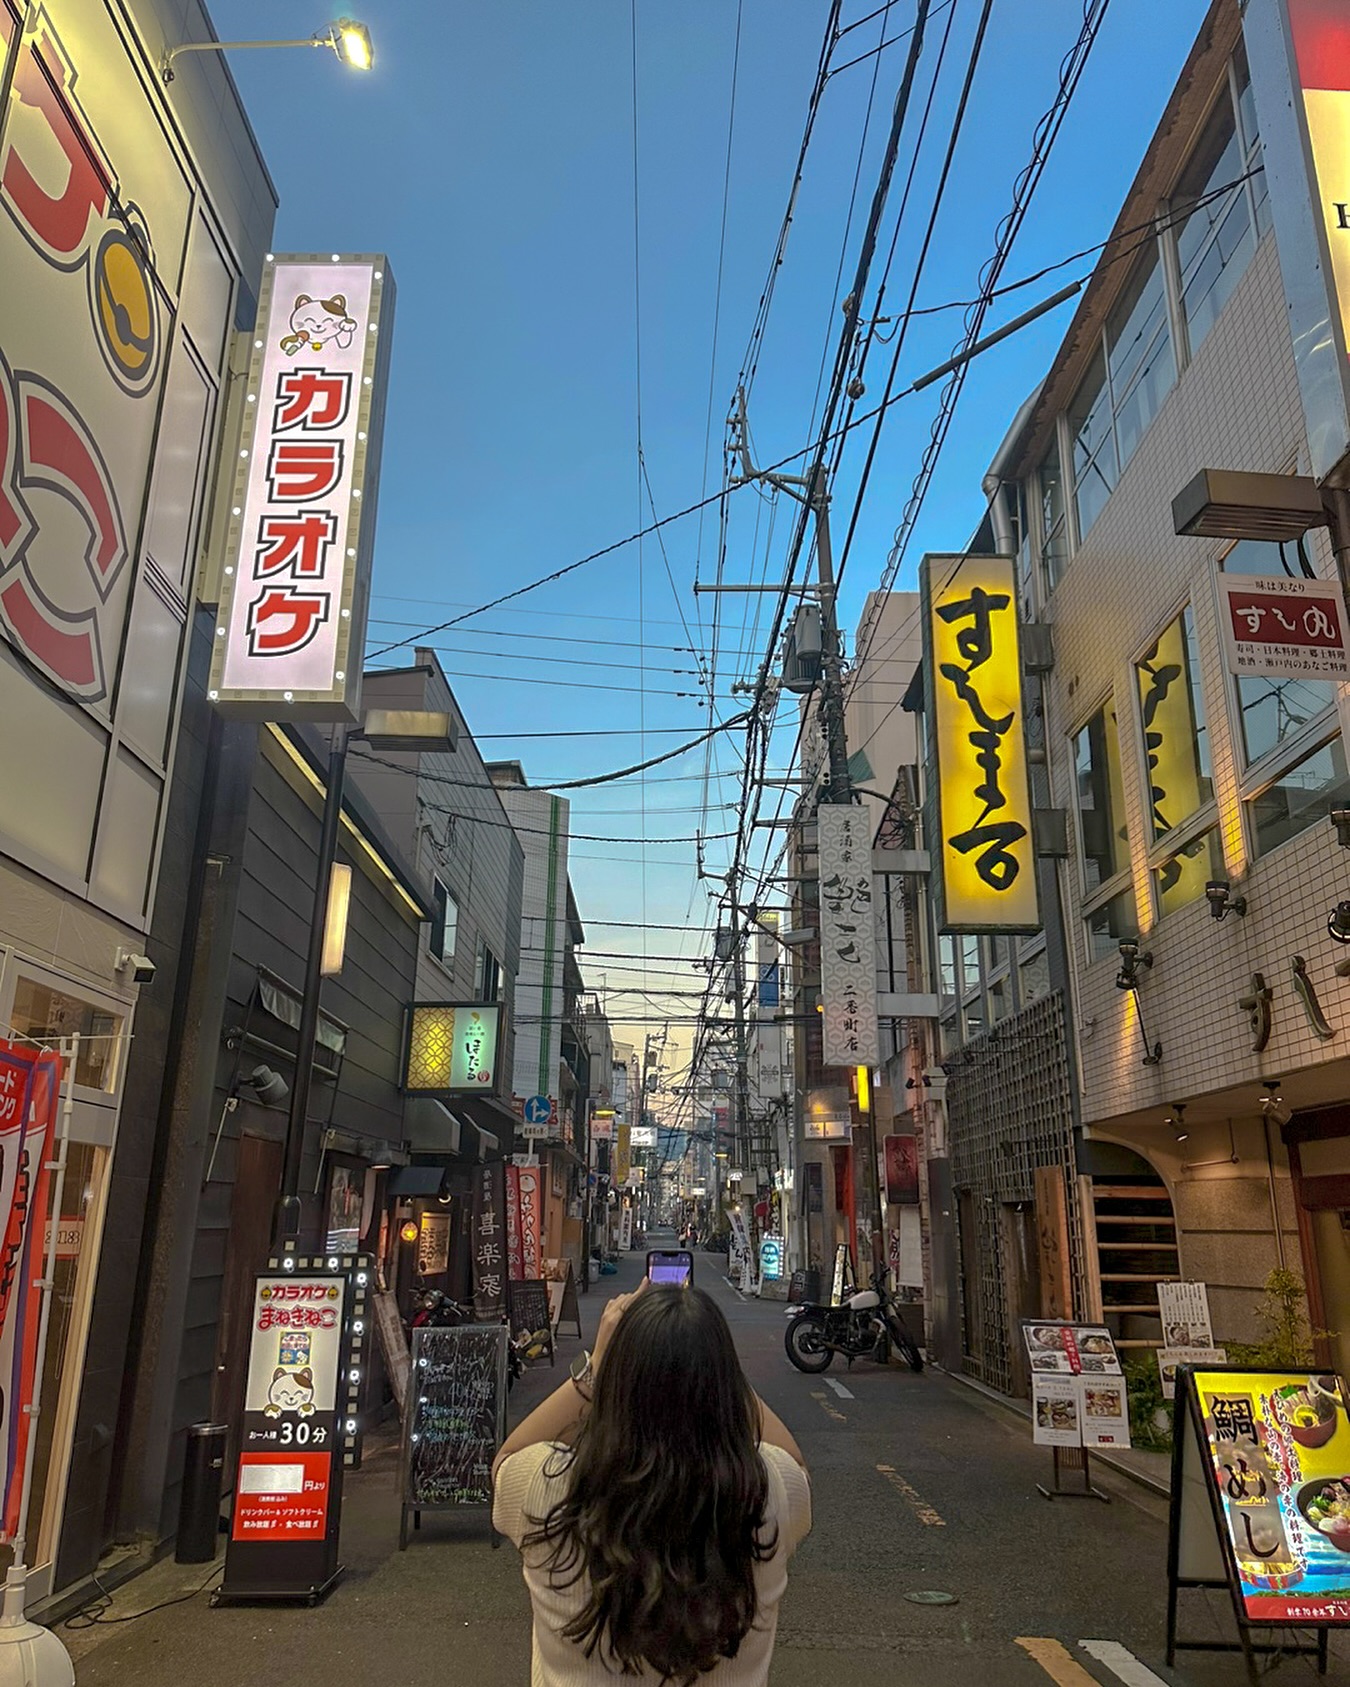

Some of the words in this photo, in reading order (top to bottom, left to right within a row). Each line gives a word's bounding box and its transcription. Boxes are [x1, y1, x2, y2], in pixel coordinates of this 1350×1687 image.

[249, 367, 352, 657] カラオケ
[1255, 580, 1305, 593] 味は美なり
[935, 587, 1028, 891] すしまる
[842, 985, 859, 1053] 二番町店
[1238, 956, 1350, 1052] すし
[465, 1039, 481, 1080] ほたる
[476, 1211, 502, 1298] 喜楽家
[270, 1284, 329, 1301] カラオケ
[257, 1302, 339, 1332] まねきねこ
[279, 1421, 328, 1445] 30分
[303, 1480, 326, 1491] 円より
[1211, 1395, 1280, 1559] 鯛めし
[1324, 1604, 1350, 1618] すし
